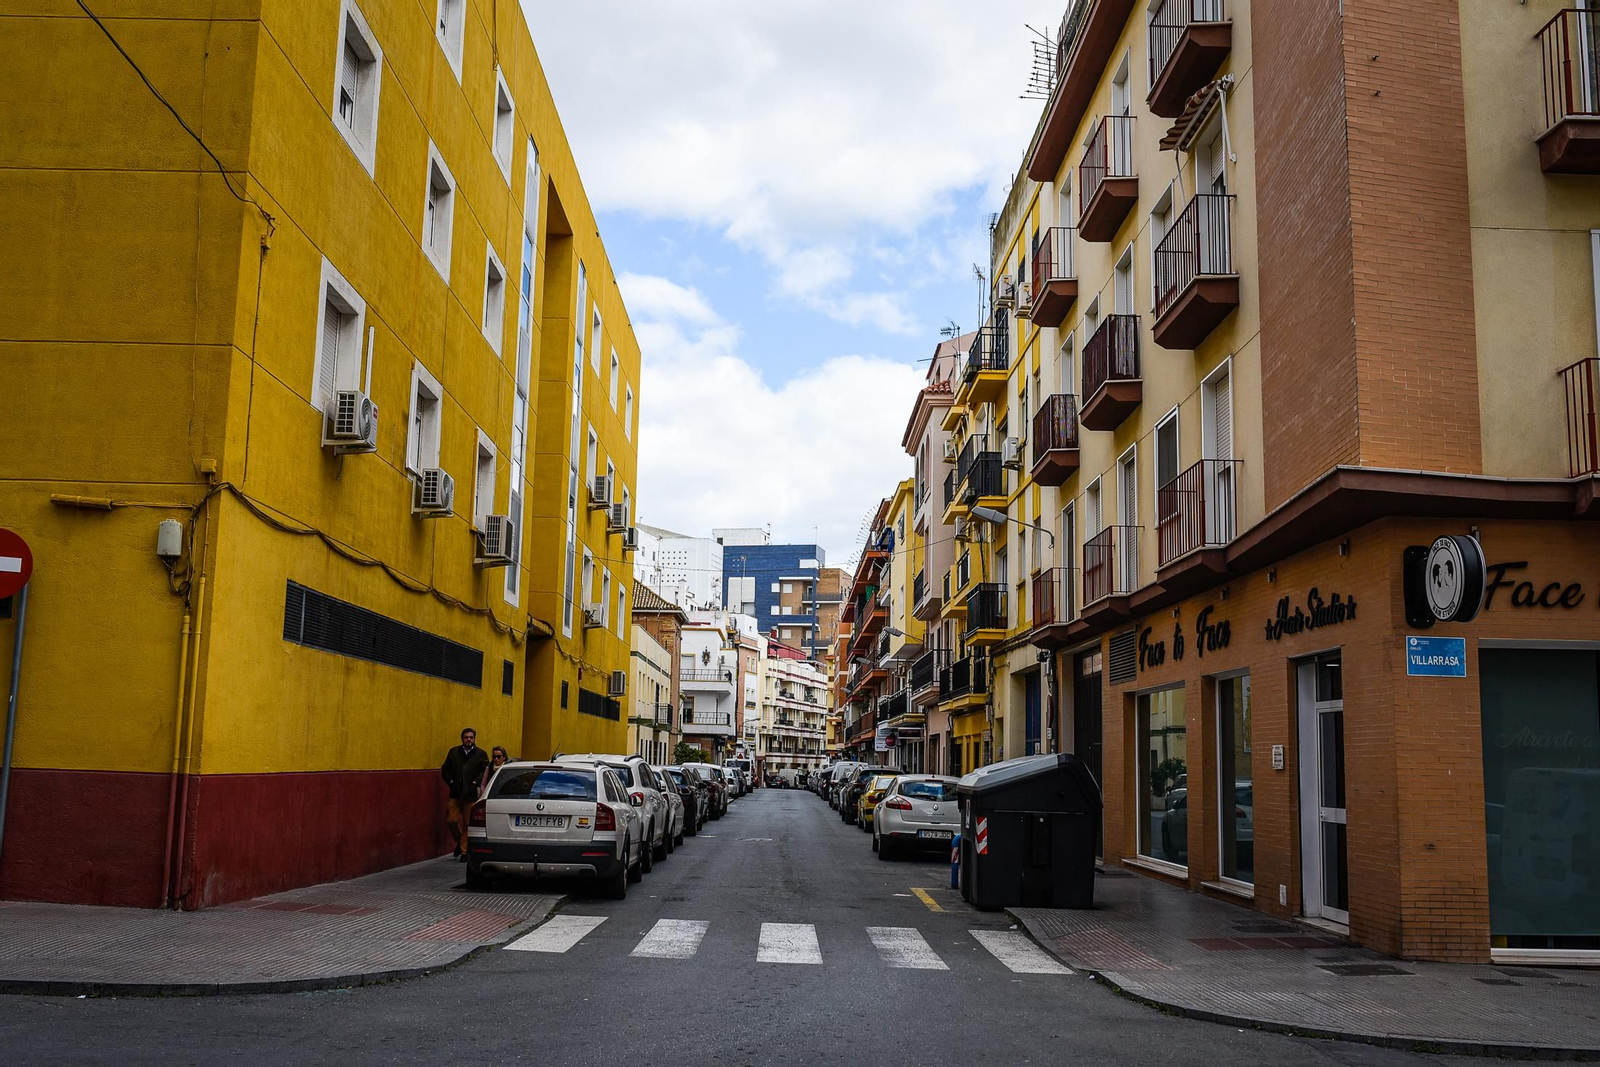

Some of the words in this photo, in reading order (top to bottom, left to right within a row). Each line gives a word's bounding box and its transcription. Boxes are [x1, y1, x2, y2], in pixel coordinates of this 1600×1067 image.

[1485, 561, 1586, 610] Face
[1304, 587, 1345, 629] Studio
[1138, 625, 1166, 672] Face
[1173, 622, 1185, 660] to
[1196, 605, 1231, 658] Face
[1410, 655, 1460, 666] VILLARRASA
[521, 817, 542, 826] 3021
[546, 817, 564, 827] FYB
